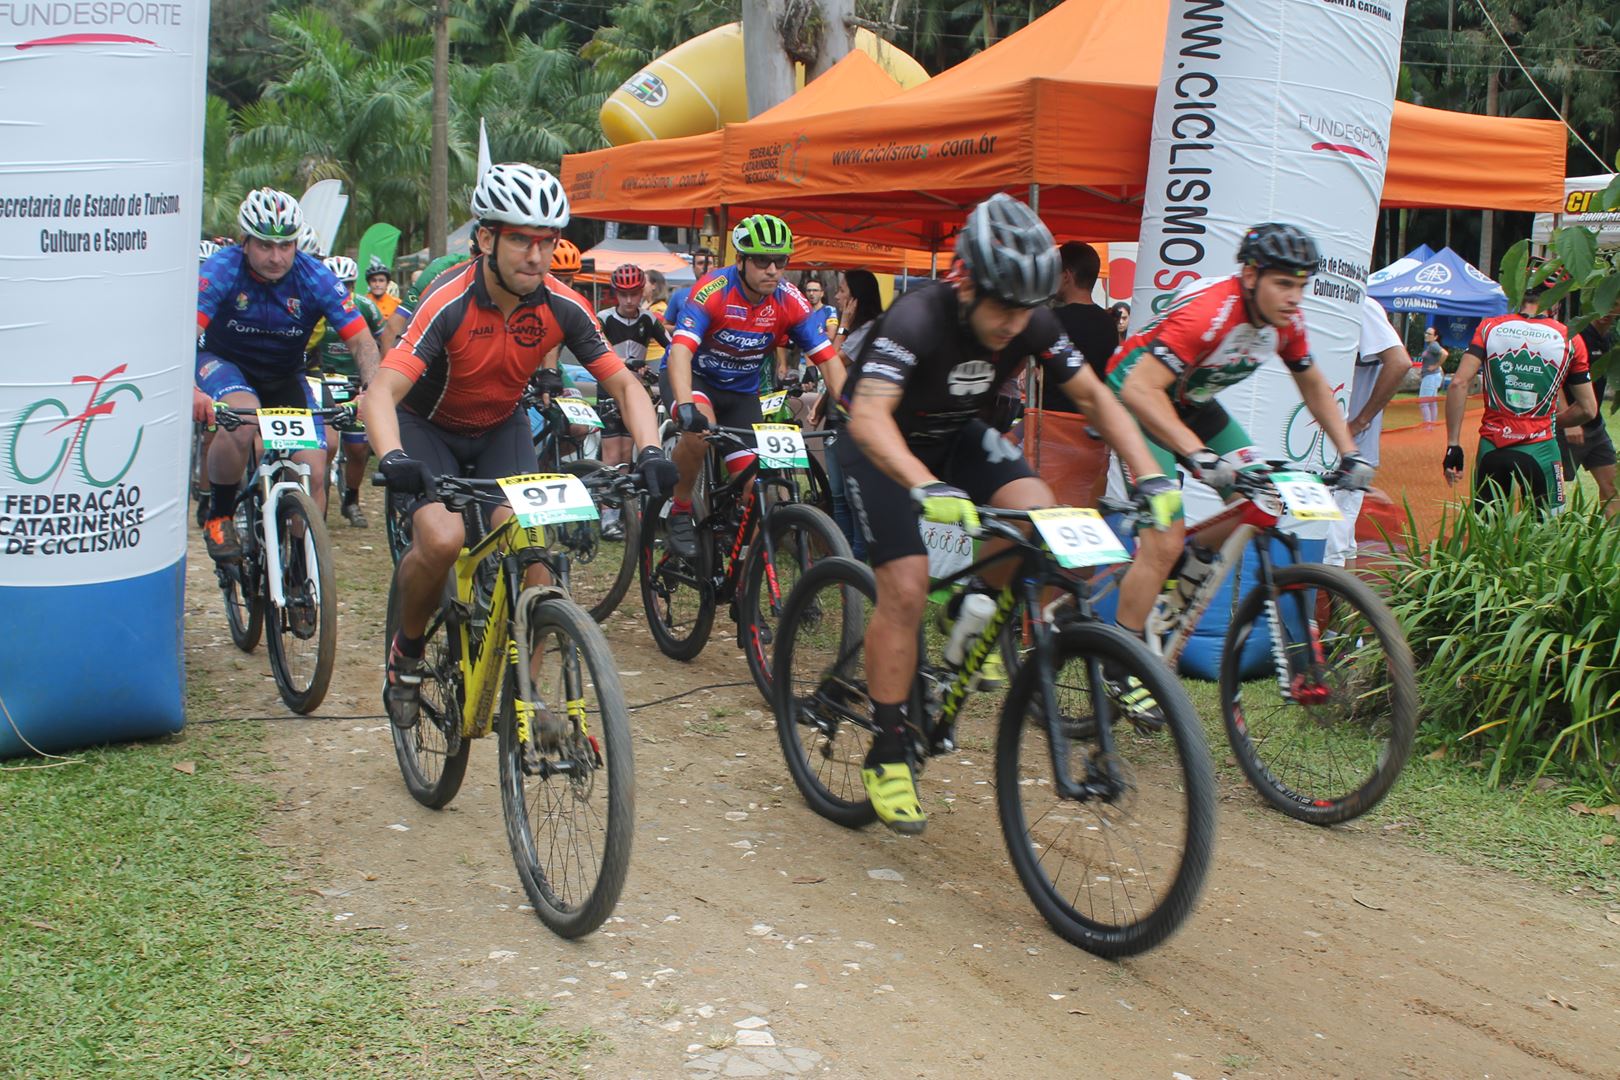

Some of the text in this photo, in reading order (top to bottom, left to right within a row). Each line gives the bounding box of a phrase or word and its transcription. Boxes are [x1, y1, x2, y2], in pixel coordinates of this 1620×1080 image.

[1358, 2, 1391, 21] CATARINA
[832, 132, 998, 166] www.ciclismos.com.br
[64, 194, 81, 218] de
[84, 193, 126, 218] Estado
[128, 193, 142, 217] de
[41, 228, 148, 254] Cultura e Esporte
[1313, 278, 1340, 299] Cultura
[1392, 284, 1453, 296] YAMAHA
[1403, 297, 1438, 309] YAMAHA
[1496, 326, 1552, 340] CONCORDIA
[1514, 363, 1544, 375] MAFEL
[271, 420, 305, 437] 95
[766, 435, 796, 454] 93
[5, 482, 141, 515] FEDERAÇÃO
[522, 483, 568, 507] 97
[0, 507, 145, 536] CATARINENSE
[5, 528, 141, 555] DE CICLISMO
